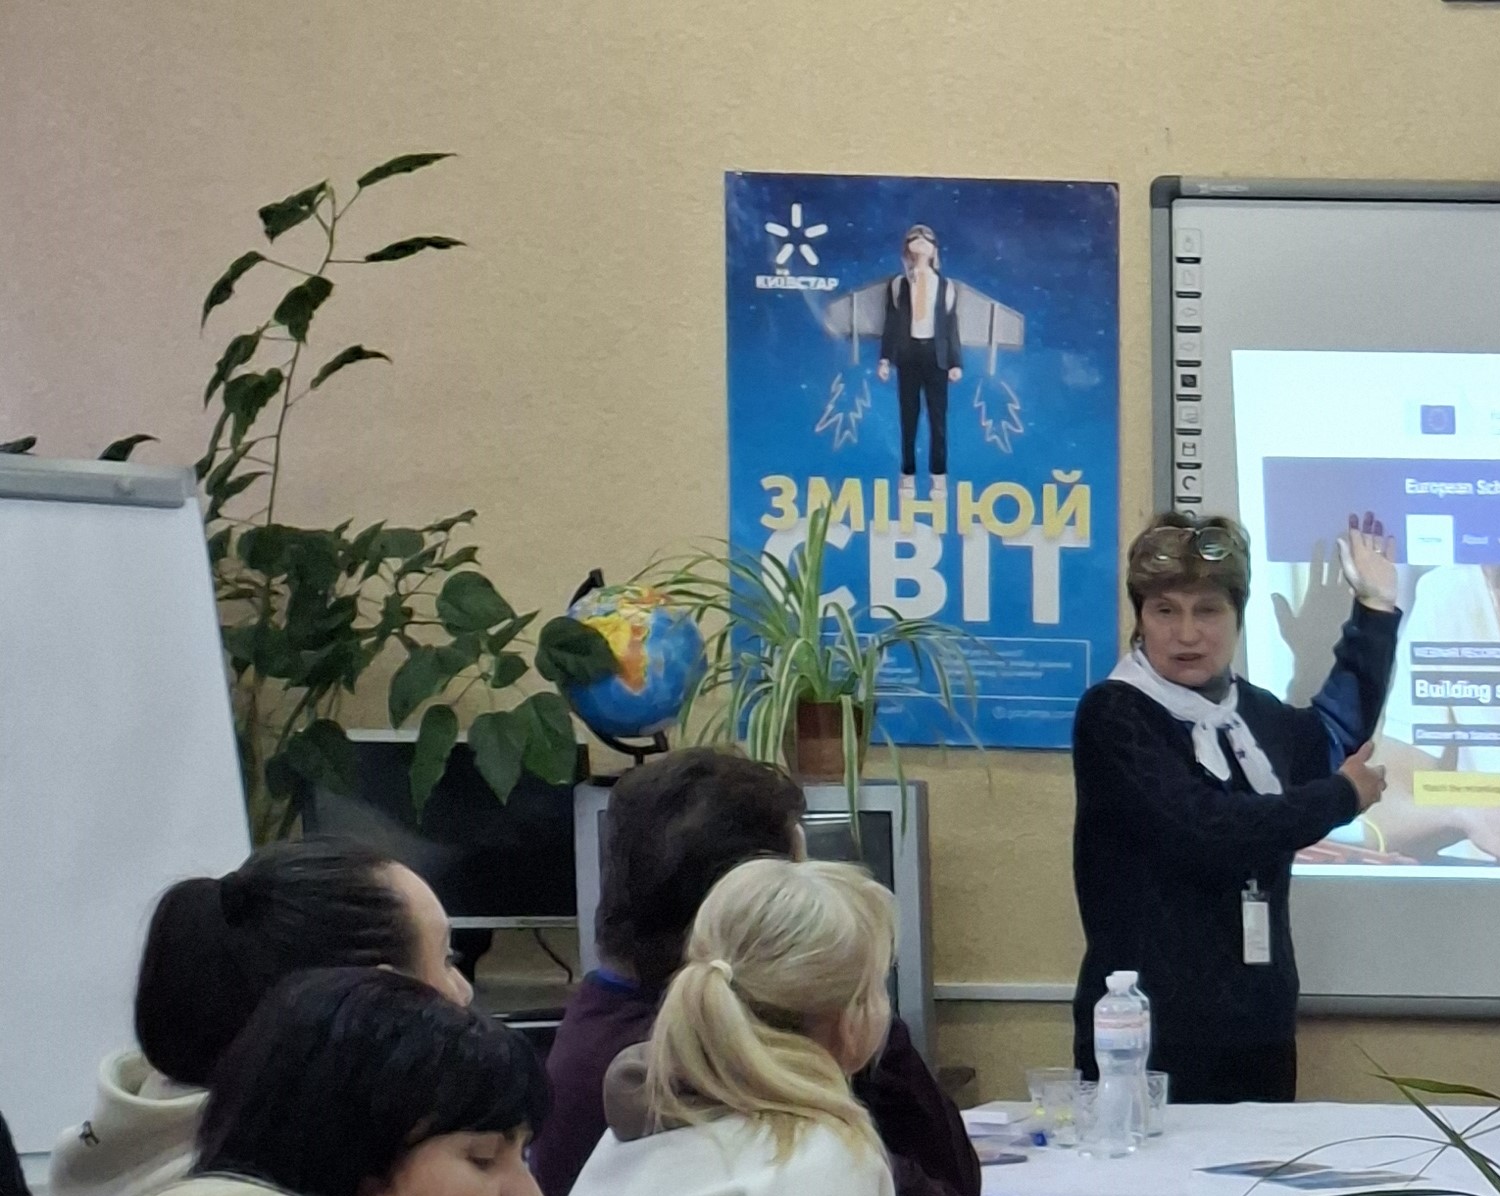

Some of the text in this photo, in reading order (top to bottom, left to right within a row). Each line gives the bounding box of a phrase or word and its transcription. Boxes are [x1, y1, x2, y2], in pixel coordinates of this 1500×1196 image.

[759, 469, 1091, 540] ЗМІНЮЙ
[1405, 478, 1473, 498] European
[760, 519, 1091, 625] СВІТ
[1415, 679, 1491, 703] Building
